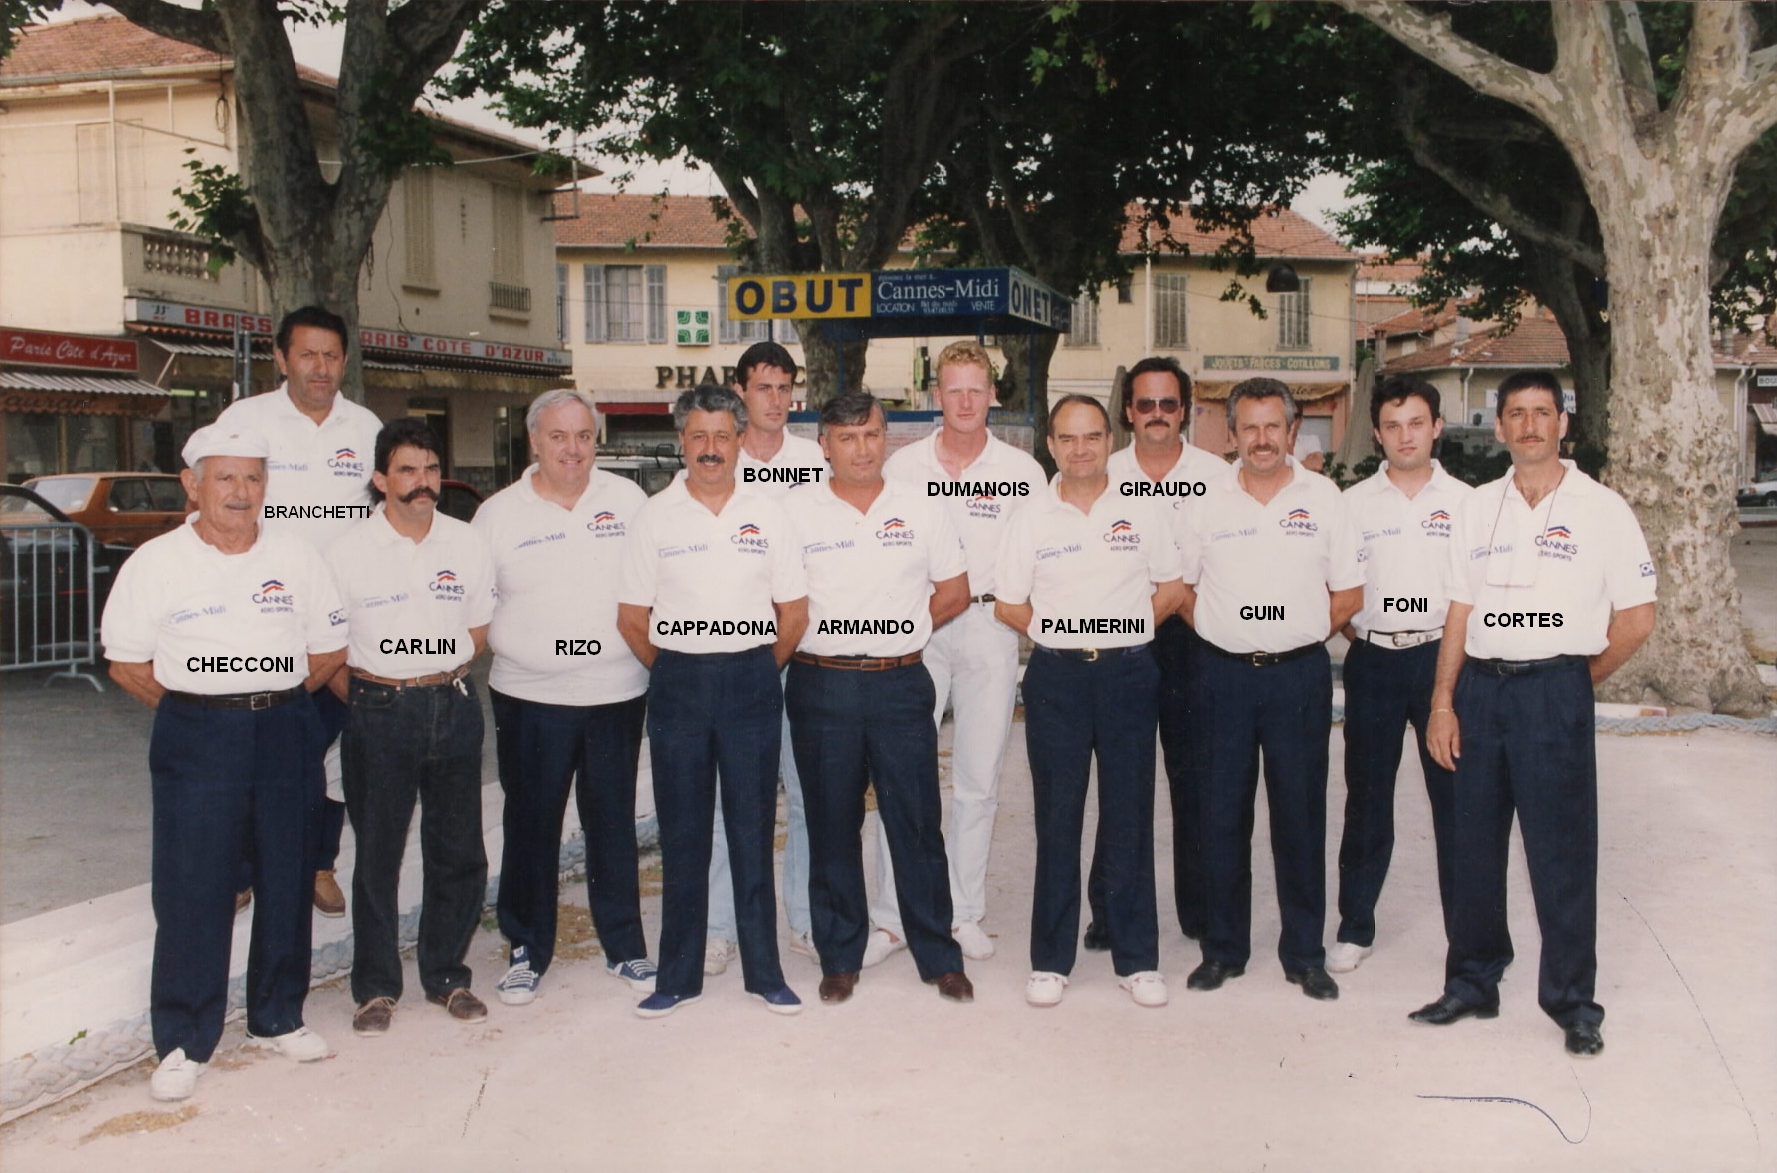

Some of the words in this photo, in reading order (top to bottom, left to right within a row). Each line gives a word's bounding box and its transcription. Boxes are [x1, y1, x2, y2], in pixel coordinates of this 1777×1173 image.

[878, 278, 999, 300] Cannes-Midi
[735, 278, 863, 315] OBUT
[876, 302, 915, 313] LOCATION
[970, 301, 995, 311] VENTE
[10, 335, 51, 356] Paris
[360, 330, 409, 349] ARIS
[422, 336, 472, 355] COTE
[485, 344, 544, 363] D'AZUR
[1211, 358, 1243, 370] JOUETS
[1250, 358, 1281, 369] FARCES
[1287, 358, 1331, 370] COTILLONS
[327, 458, 365, 473] CANNES
[966, 499, 1001, 514] CANNES
[586, 521, 626, 533] CANNES
[1279, 518, 1318, 532] CANNES
[1421, 519, 1452, 531] CANNE
[730, 533, 769, 549] CANNES
[875, 529, 915, 540] CANNES
[1103, 532, 1141, 544] CANNES
[1534, 535, 1578, 555] CANNES
[429, 581, 465, 595] CANNES
[252, 593, 294, 606] CANNES
